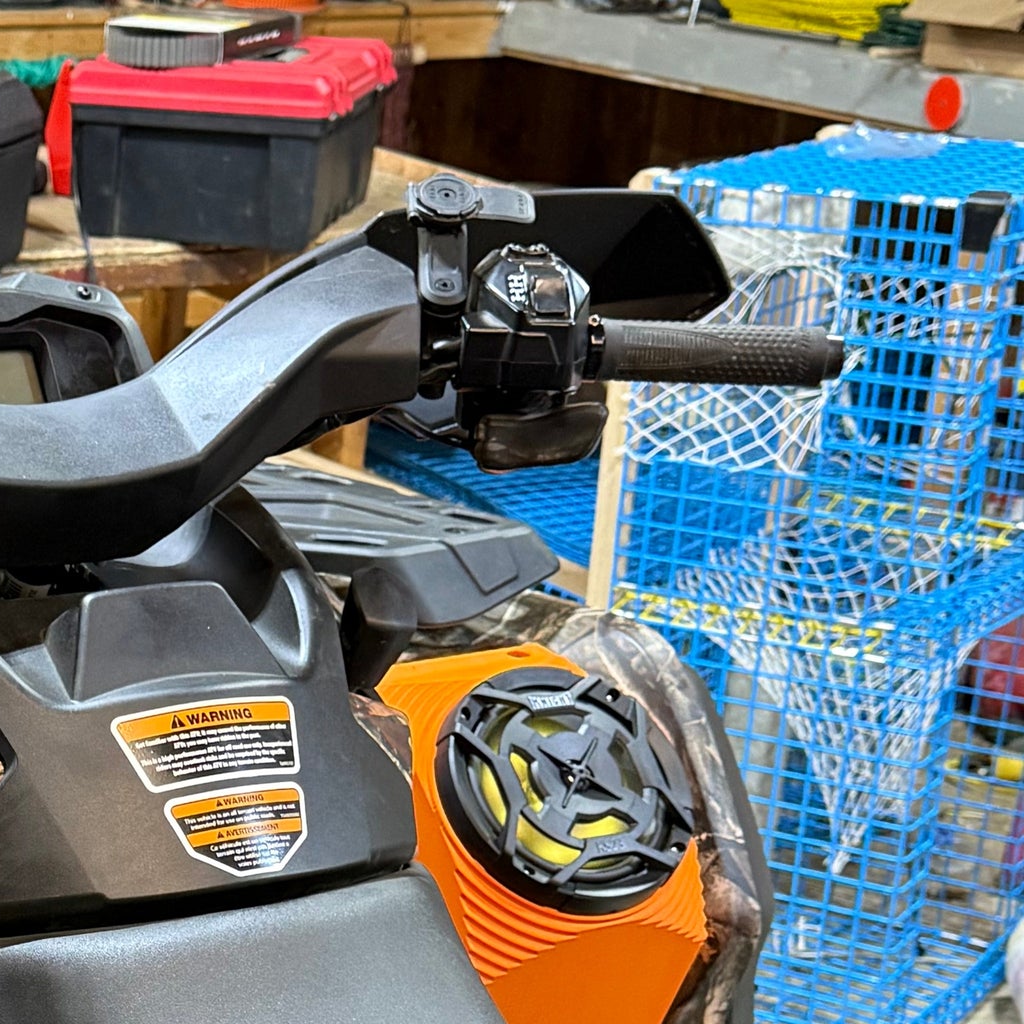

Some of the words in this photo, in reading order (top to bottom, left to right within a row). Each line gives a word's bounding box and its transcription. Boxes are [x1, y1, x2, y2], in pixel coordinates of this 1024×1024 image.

[186, 708, 253, 725] WARNING
[223, 794, 264, 806] WARNING
[226, 823, 280, 838] AVERTISSEMENT
